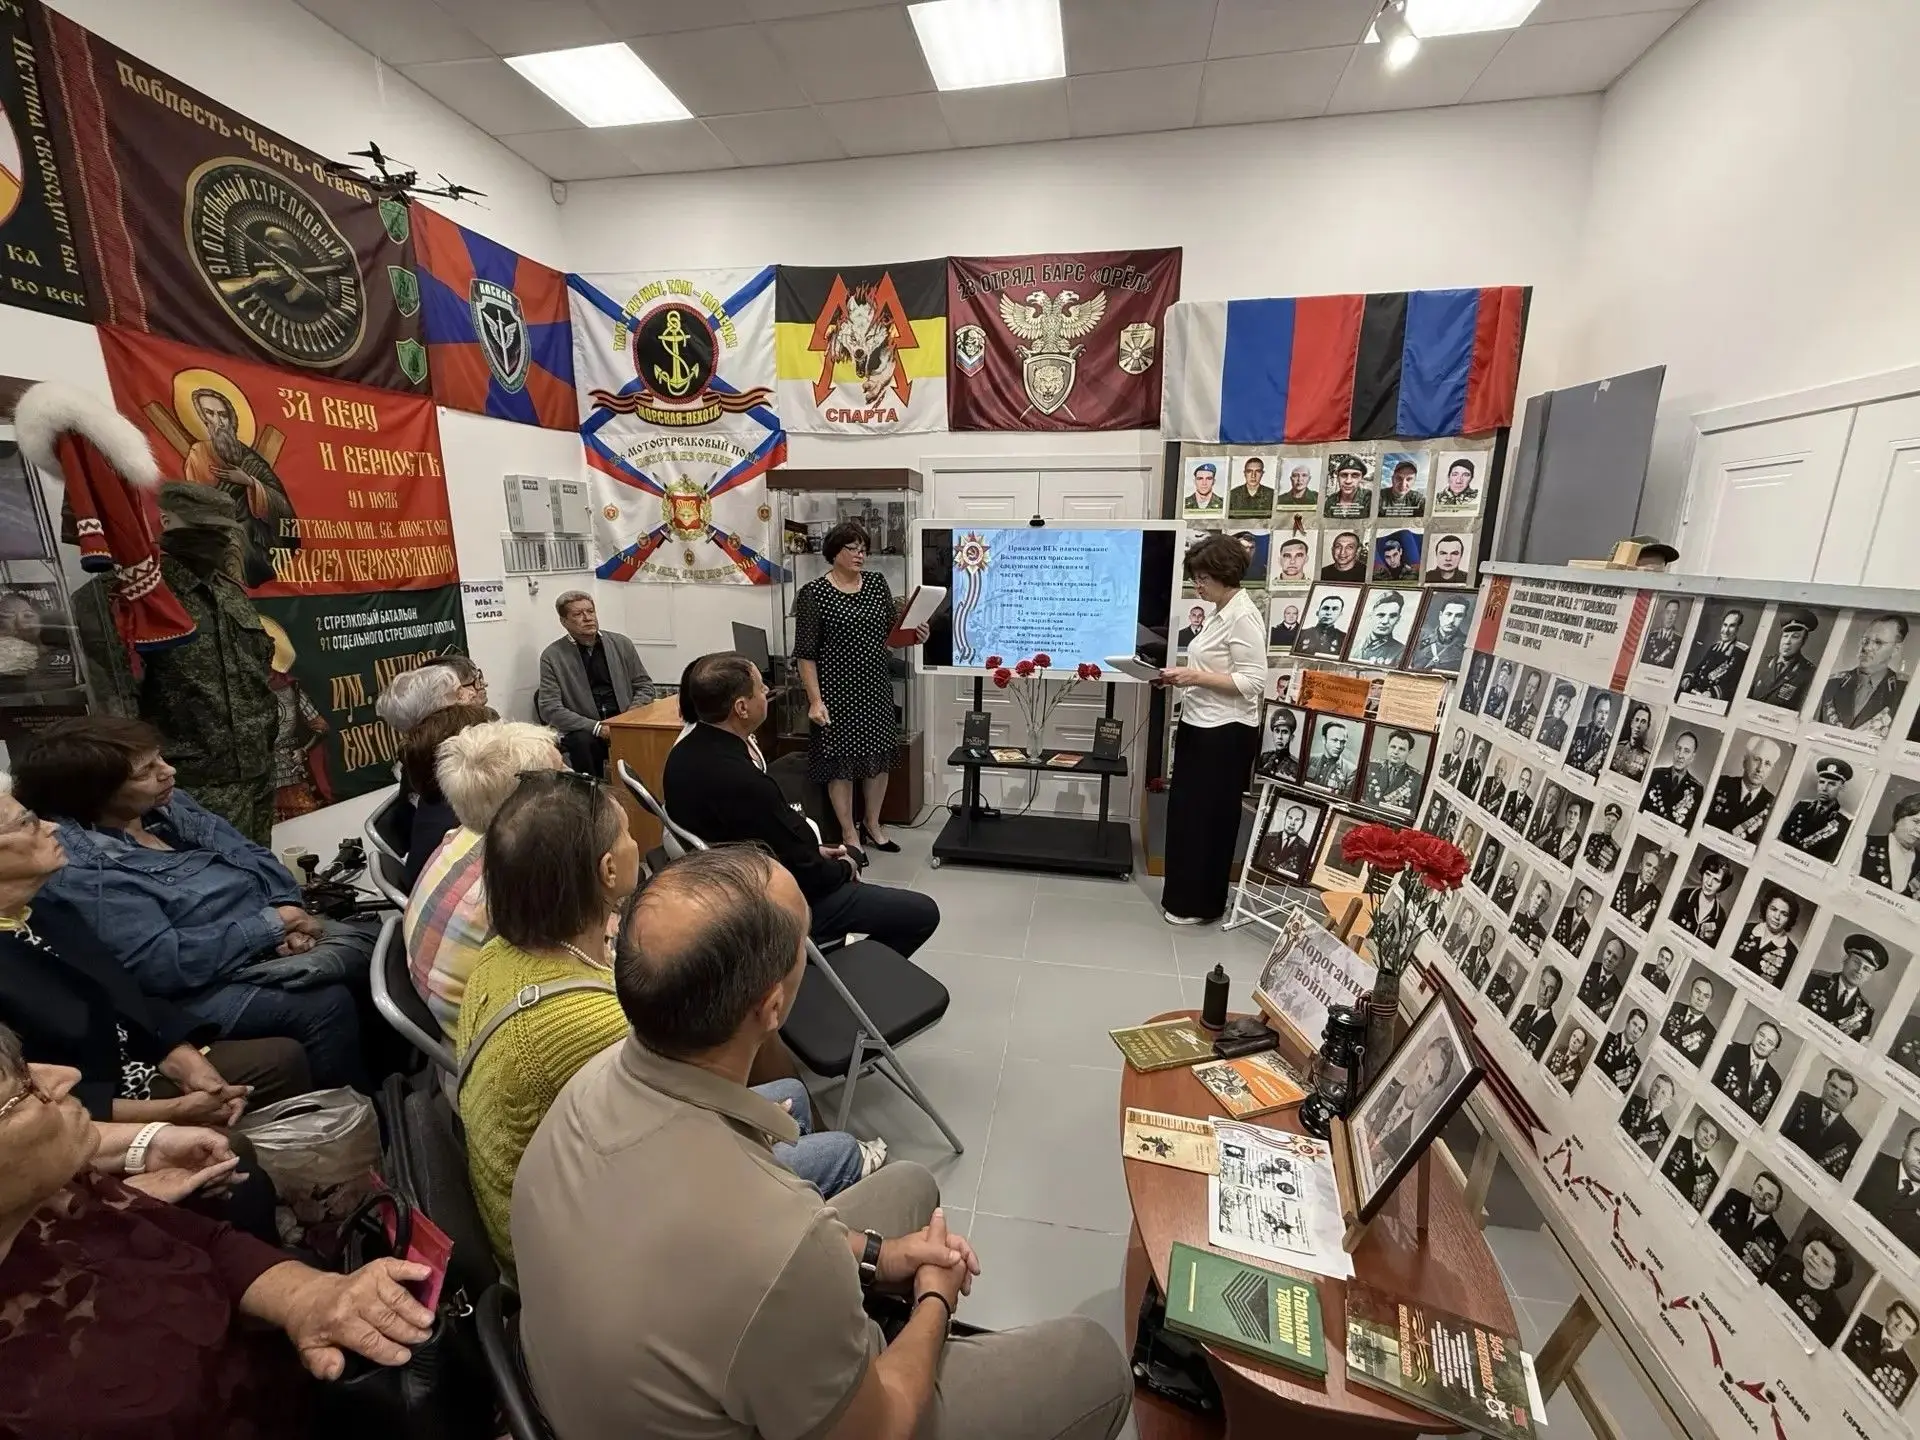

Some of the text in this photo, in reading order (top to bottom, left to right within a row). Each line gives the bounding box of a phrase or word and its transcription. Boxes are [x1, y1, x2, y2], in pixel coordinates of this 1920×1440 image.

[202, 174, 250, 254] ОТДЕЛЬНЫЙ
[249, 178, 346, 259] СТРЕЛКОВЫЙ
[339, 275, 358, 316] ПОЛК
[667, 279, 693, 297] ТАМ
[980, 265, 1036, 294] ОТРЯД
[1042, 263, 1086, 283] БАРС
[1089, 264, 1153, 295] «ОРЁЛ»
[479, 282, 512, 304] КАСКАД
[277, 387, 379, 433] ЗА ВЕРУ
[825, 407, 899, 424] СПАРТА
[318, 442, 440, 477] И ВЕРНОСТЬ
[628, 437, 729, 459] МОТОСТРЕЛКОВЫЙ
[348, 489, 399, 509] 91 ПОЛК
[279, 518, 350, 539] БАТАЛЬОН
[269, 544, 455, 588] АНДРЕЯ ПЕРВОЗВАННОГО
[463, 585, 504, 594] Вместе
[474, 597, 493, 606] мы
[323, 609, 379, 631] СТРЕЛКОВЫЙ
[380, 607, 418, 624] БАТАЛЬОН
[476, 611, 503, 619] сила
[332, 630, 384, 650] ОТДЕЛЬНОГО
[384, 624, 434, 642] СТРЕЛКОВОГО
[330, 673, 373, 723] ИМ.
[1296, 934, 1364, 999] Дорогами
[1275, 1287, 1294, 1345] тараном
[1292, 1285, 1312, 1358] Стальным
